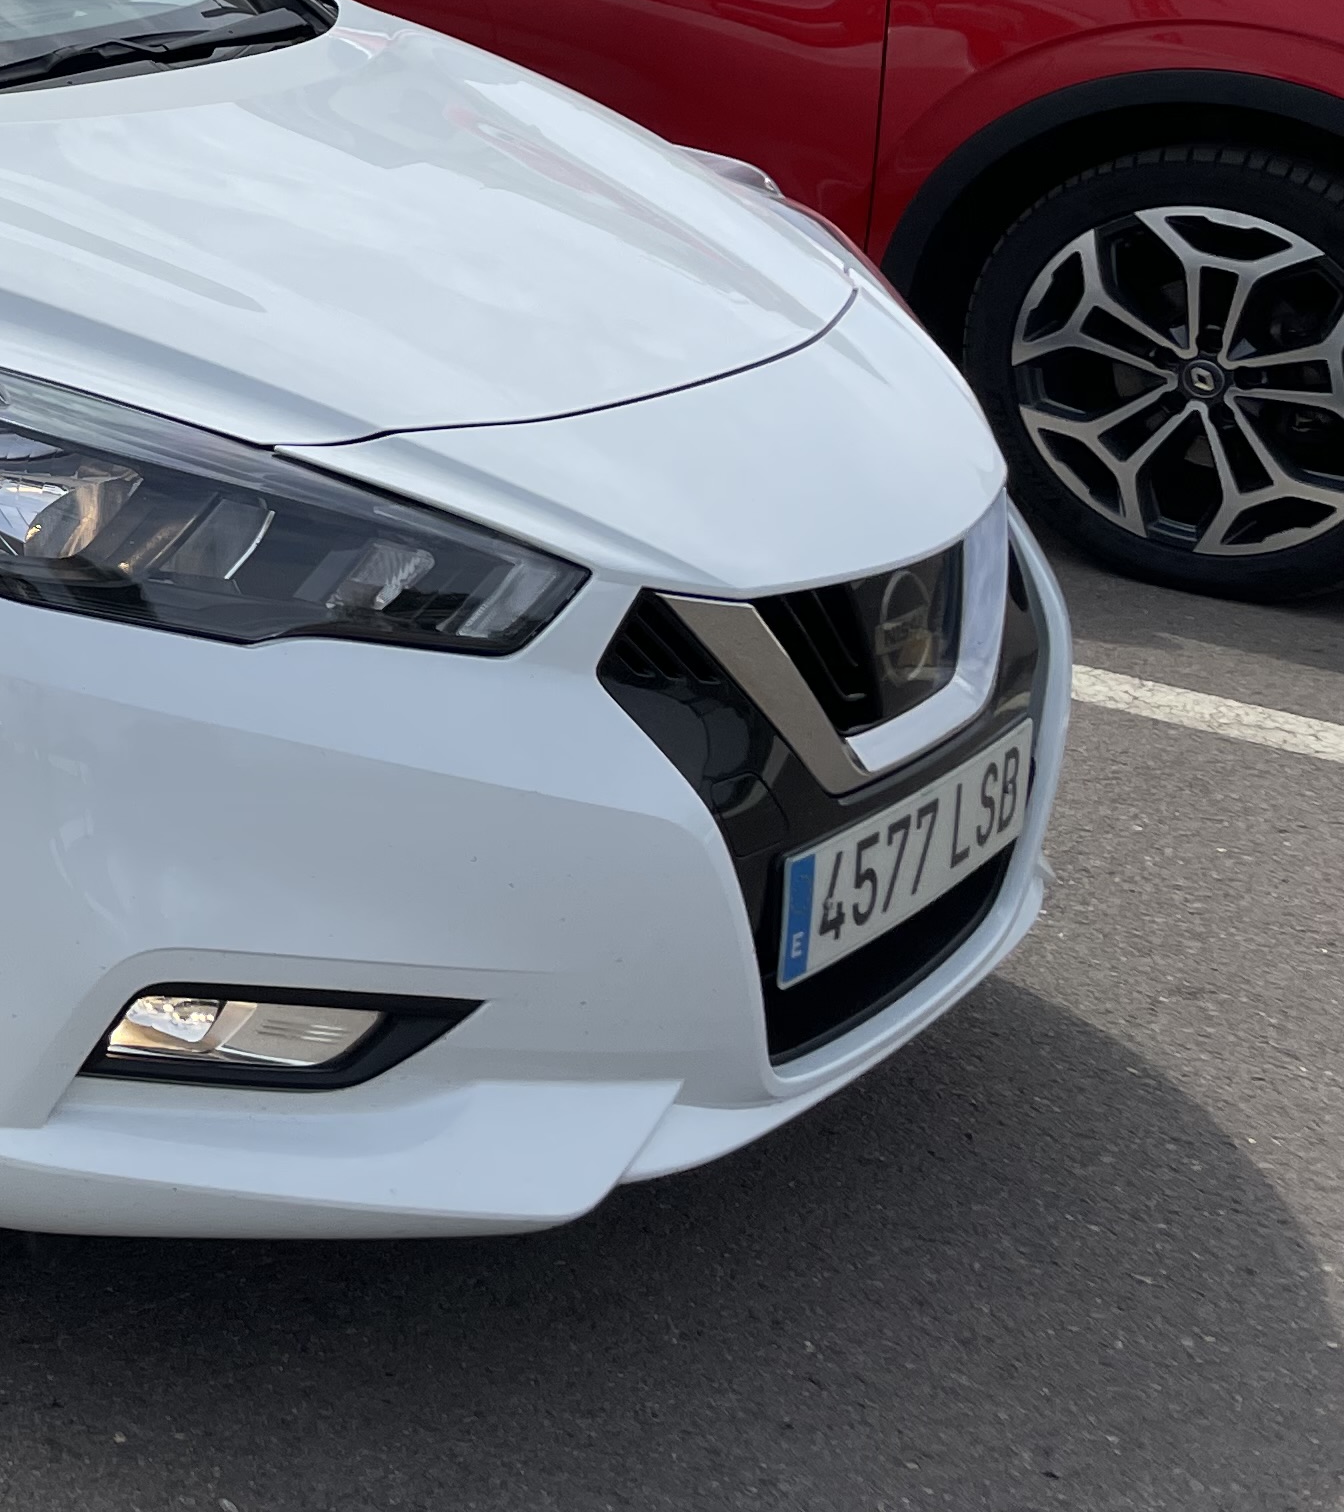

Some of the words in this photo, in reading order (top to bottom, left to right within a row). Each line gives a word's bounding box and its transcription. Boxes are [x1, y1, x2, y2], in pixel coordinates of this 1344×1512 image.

[818, 796, 939, 941] 4577
[949, 745, 1022, 871] LSB
[790, 931, 805, 959] E
